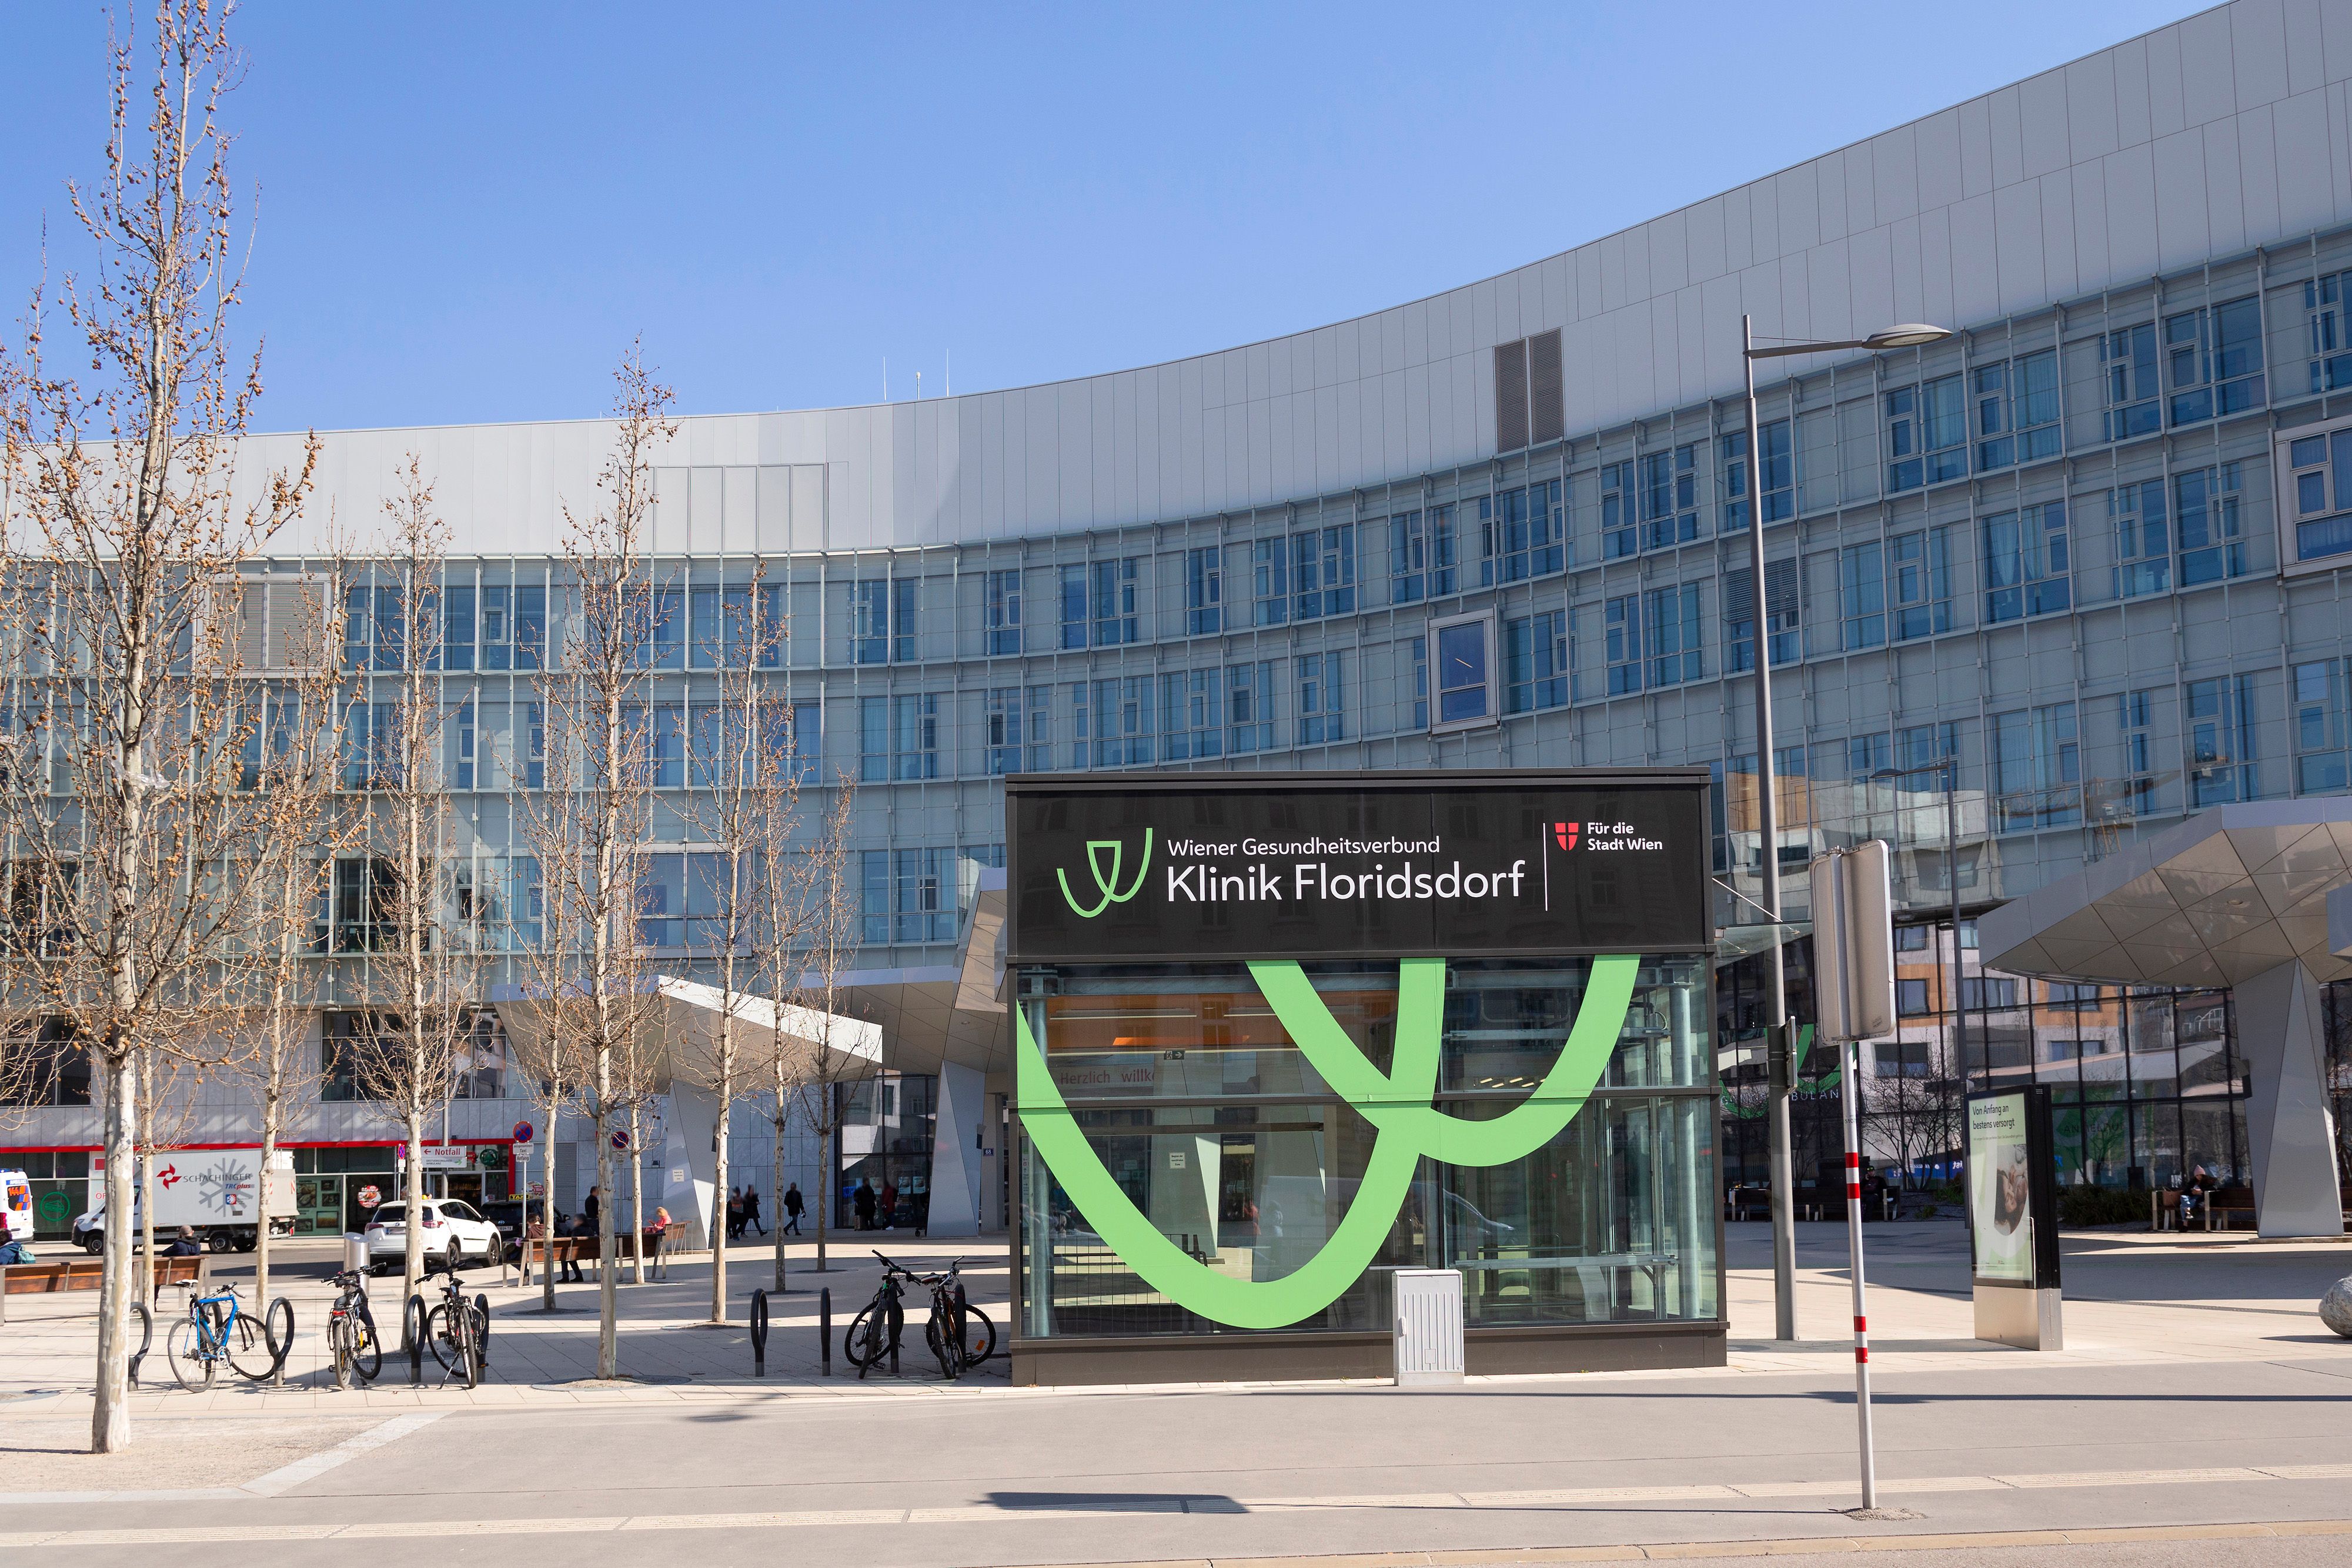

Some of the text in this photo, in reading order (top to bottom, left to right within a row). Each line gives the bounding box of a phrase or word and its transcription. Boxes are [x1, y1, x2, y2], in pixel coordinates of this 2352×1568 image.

[1588, 822, 1634, 834] Für die
[1168, 835, 1440, 856] Wiener Gesundheitsverbund
[1588, 838, 1663, 851] Stadt Wien
[1168, 860, 1526, 901] Klinik Floridsdorf
[1060, 1069, 1110, 1085] Herzlich
[1973, 1105, 1983, 1115] Von
[1983, 1104, 2002, 1116] Anfang
[1973, 1118, 2015, 1129] bestens versorgt
[183, 1173, 252, 1183] SCHACHINGER
[8, 1186, 19, 1196] 144
